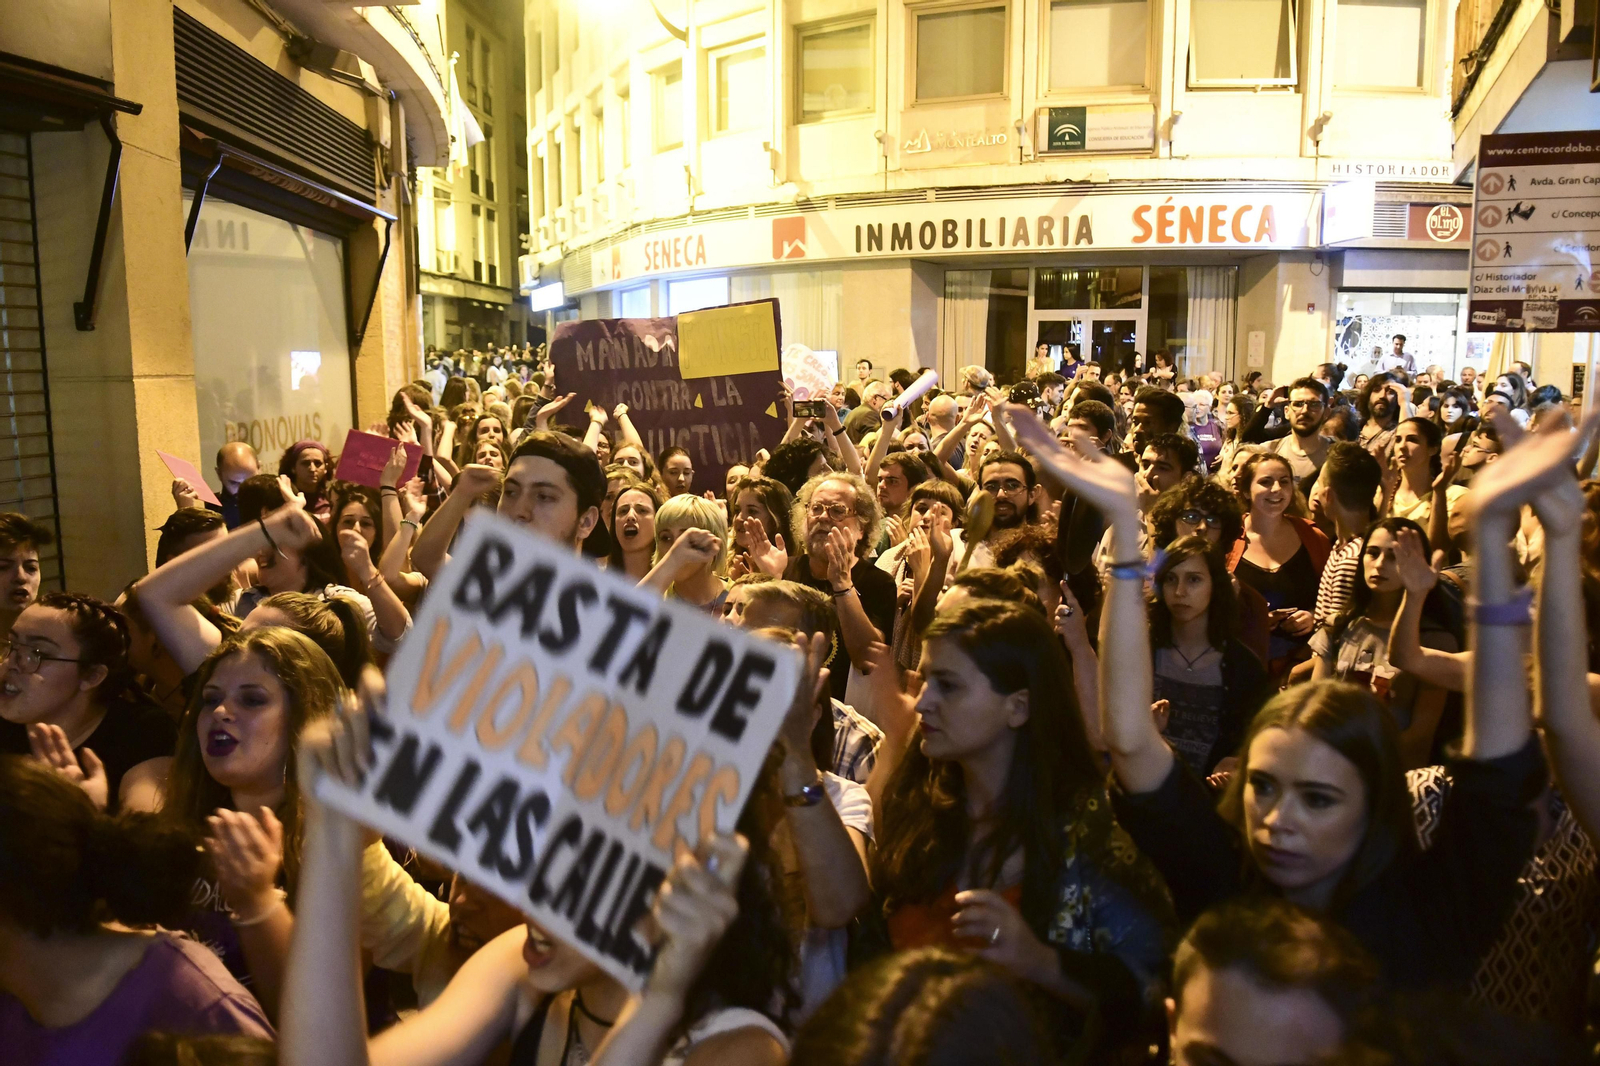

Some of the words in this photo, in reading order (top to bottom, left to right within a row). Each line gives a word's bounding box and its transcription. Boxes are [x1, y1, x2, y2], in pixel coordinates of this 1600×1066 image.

[937, 133, 1007, 149] MONTEALTO
[1332, 164, 1450, 176] HISTORIADOR
[1530, 177, 1556, 186] Avda.
[1558, 176, 1581, 185] Gran
[855, 214, 1094, 253] INMOBILIARIA
[1131, 196, 1277, 244] SÉNECA
[644, 234, 706, 271] SENECA
[1475, 273, 1484, 282] c/
[1486, 272, 1537, 281] Historiador
[1495, 285, 1509, 293] del
[709, 376, 743, 406] LA
[225, 412, 322, 455] PRONOVIAS
[452, 537, 673, 696] BASTA
[674, 641, 776, 744] DE
[428, 760, 551, 881] LAS
